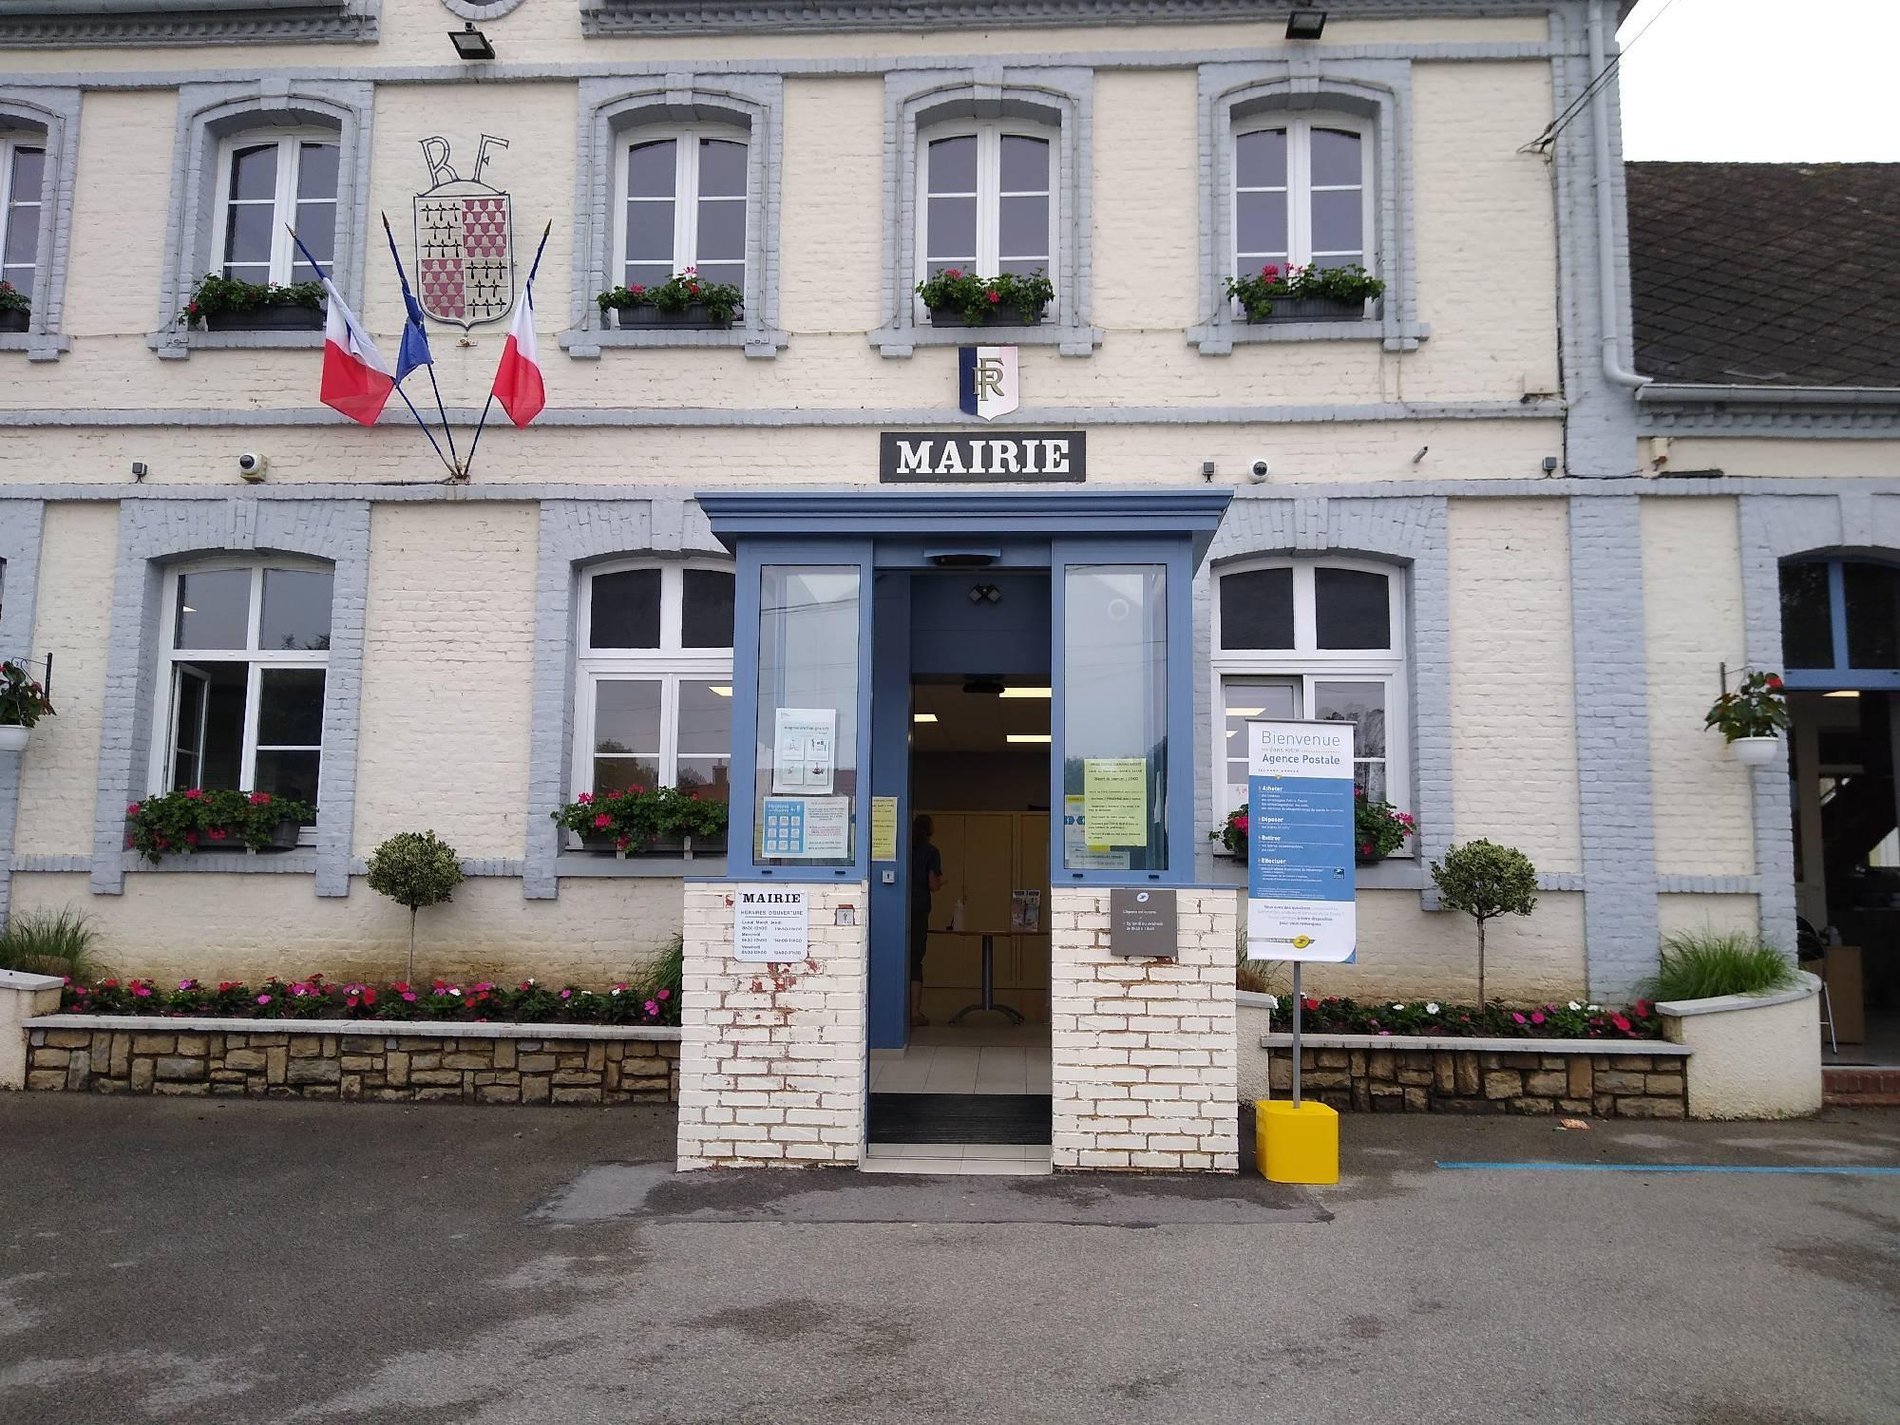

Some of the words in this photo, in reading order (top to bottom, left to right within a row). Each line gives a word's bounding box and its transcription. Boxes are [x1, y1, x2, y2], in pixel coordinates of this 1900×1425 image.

[896, 439, 1070, 474] MAIRIE
[1261, 730, 1340, 746] Bienvenue
[1262, 754, 1299, 764] Agence
[1302, 755, 1340, 765] Postale
[743, 893, 801, 903] MAIRIE
